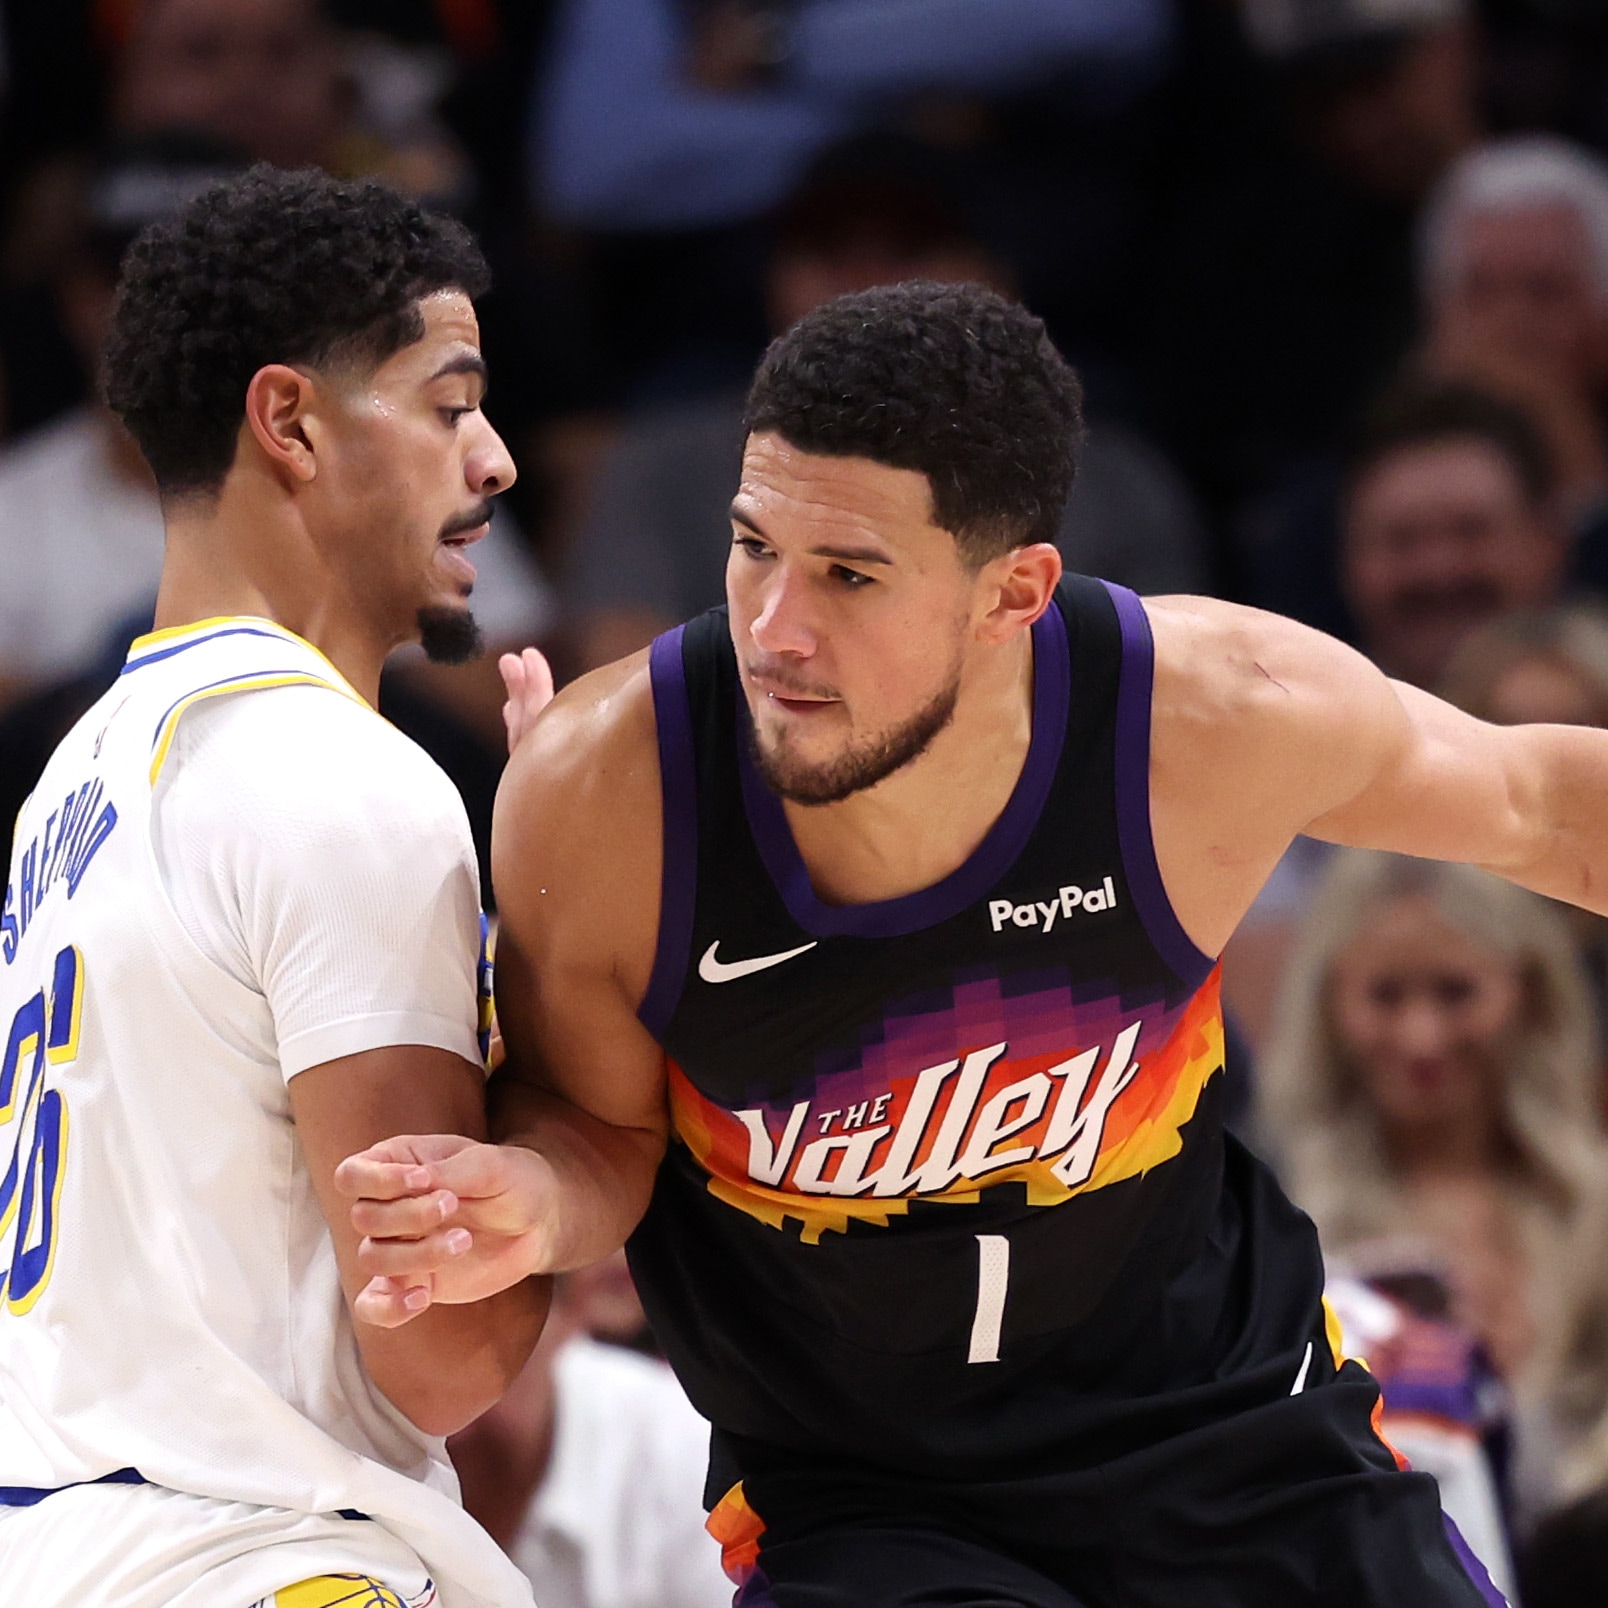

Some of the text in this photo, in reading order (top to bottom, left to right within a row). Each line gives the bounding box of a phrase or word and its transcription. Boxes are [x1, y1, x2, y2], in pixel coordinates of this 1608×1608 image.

[988, 876, 1117, 933] PayPal
[731, 1020, 1142, 1198] Valley
[817, 1092, 894, 1134] THE
[967, 1234, 1010, 1364] 1
